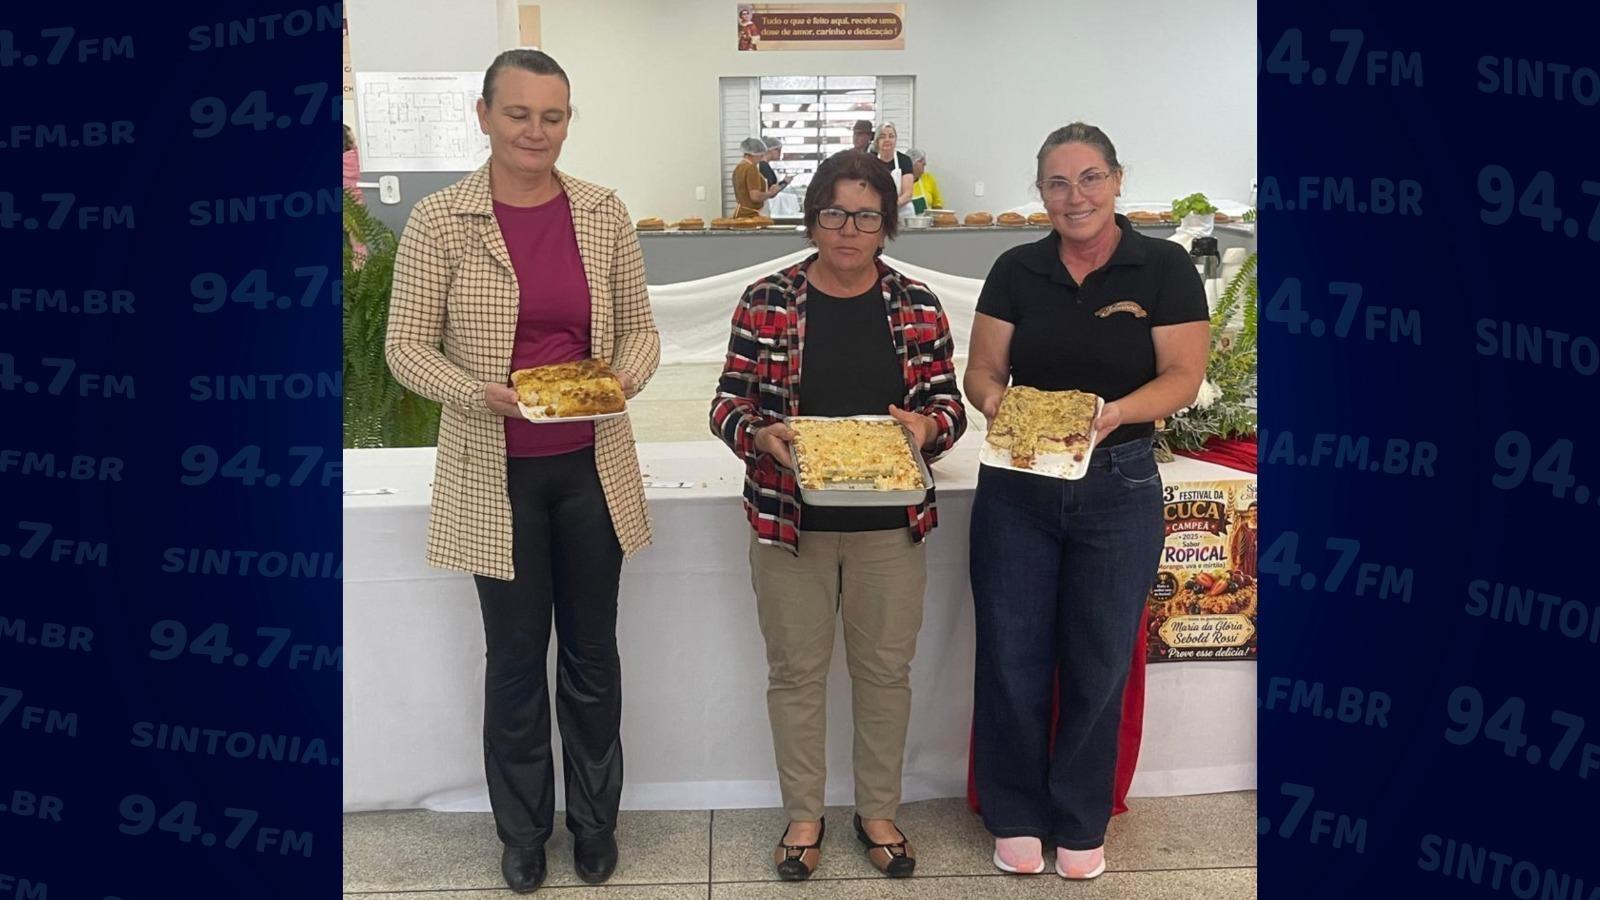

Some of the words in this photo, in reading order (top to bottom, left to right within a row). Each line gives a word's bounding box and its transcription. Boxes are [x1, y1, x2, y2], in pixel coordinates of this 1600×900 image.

[816, 28, 846, 36] carinho
[853, 28, 893, 36] dedicação
[1180, 491, 1212, 500] FESTIVAL
[1214, 490, 1223, 499] DA
[1164, 501, 1219, 520] CUCA
[1172, 521, 1209, 531] CAMPEÃ
[1171, 622, 1198, 631] Maria
[1215, 621, 1242, 633] Glória
[1174, 633, 1209, 644] Sebold
[1213, 631, 1239, 644] Rossi
[1168, 648, 1194, 658] Prove
[1215, 647, 1249, 656] delícia!
